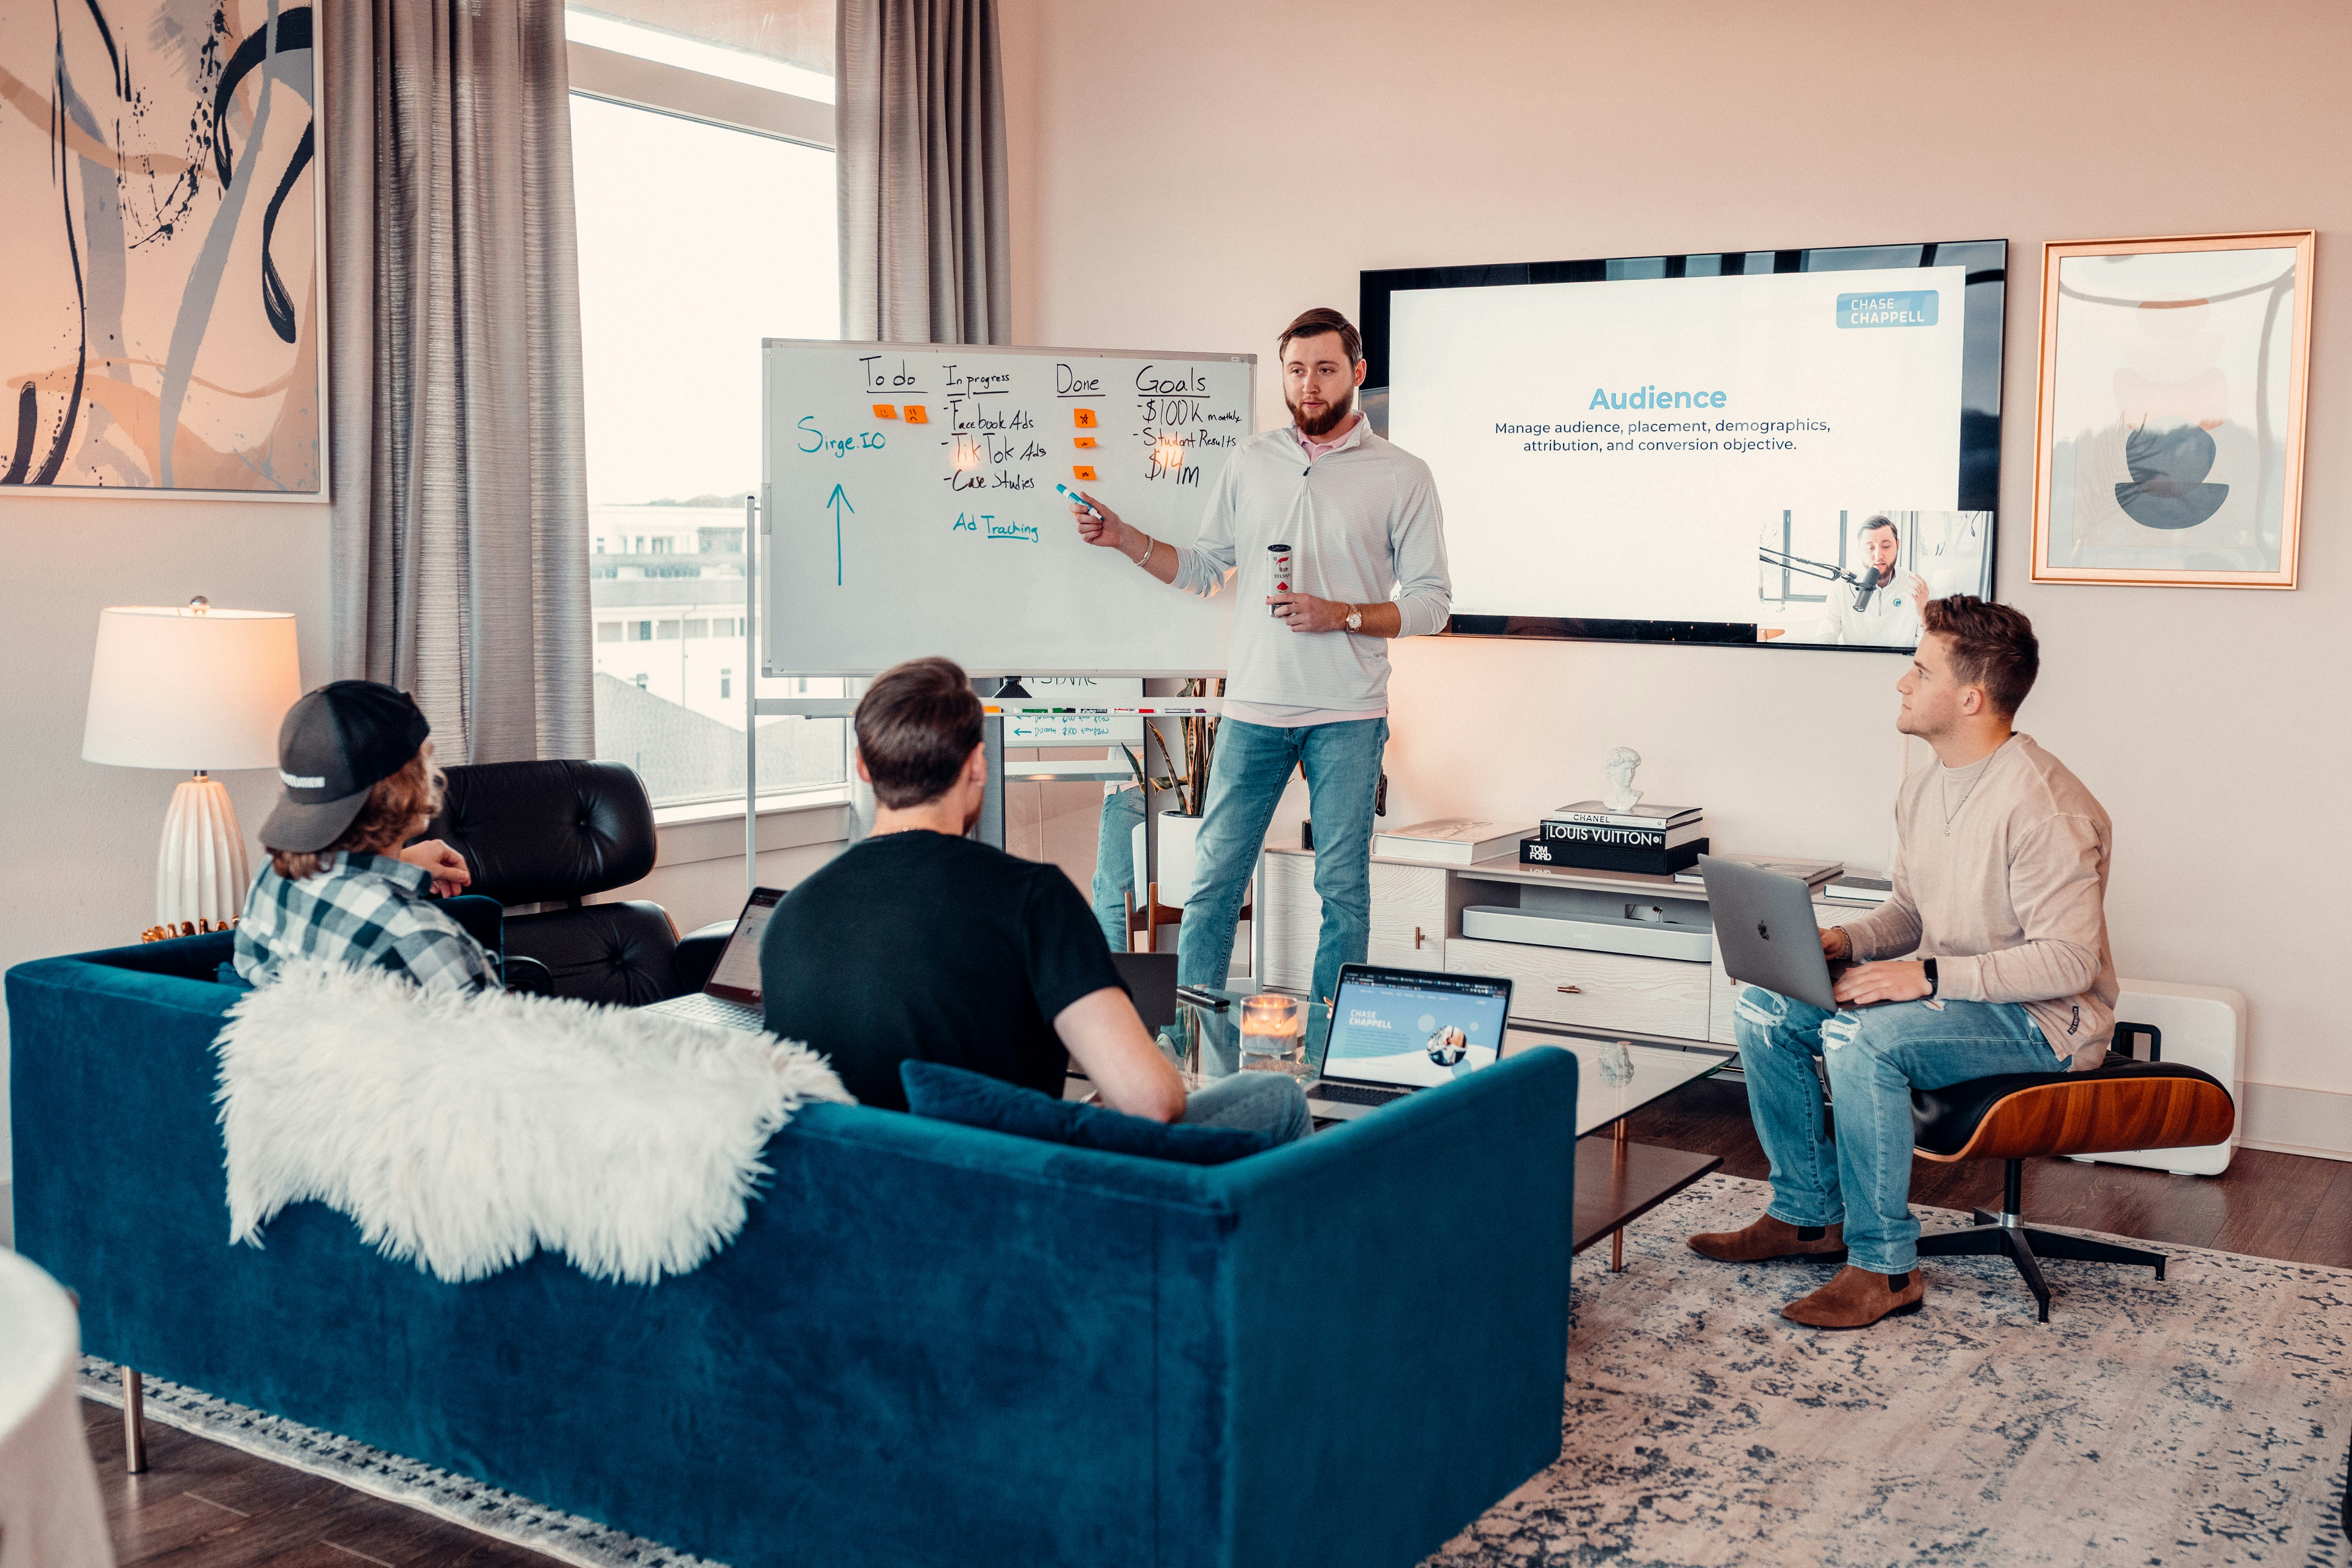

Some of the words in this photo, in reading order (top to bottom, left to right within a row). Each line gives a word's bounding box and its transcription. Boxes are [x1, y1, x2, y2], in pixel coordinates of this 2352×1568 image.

[1851, 298, 1895, 311] CHASE
[1851, 310, 1924, 325] CHAPPELL
[859, 356, 885, 387] To
[893, 359, 915, 386] do
[1056, 363, 1100, 394] Done
[1135, 365, 1206, 394] Goals
[943, 365, 962, 386] In
[967, 373, 1010, 399] progress
[1588, 385, 1727, 410] Audience
[1009, 410, 1034, 430] Ads
[1208, 410, 1242, 423] monthly
[1495, 422, 1551, 436] Manage
[1555, 420, 1624, 435] audience,
[1628, 420, 1711, 435] placement,
[1715, 418, 1831, 435] demographics,
[1199, 429, 1236, 448] Results
[1523, 439, 1602, 452] attribution,
[1607, 438, 1634, 451] and
[1638, 438, 1718, 451] conversion
[1723, 437, 1797, 452] objective.
[1019, 440, 1047, 461] Ads
[991, 469, 1035, 490] Studies
[953, 512, 977, 531] Ad
[981, 515, 1038, 543] Tracking
[1573, 814, 1610, 823] CHANEL
[1549, 826, 1588, 840] LOUIS
[1592, 829, 1652, 846] VUITTON
[1529, 845, 1548, 854] TOM
[1530, 852, 1552, 861] FORD
[1349, 1016, 1392, 1029] CHAPPELL
[1350, 1009, 1377, 1019] CHASE
